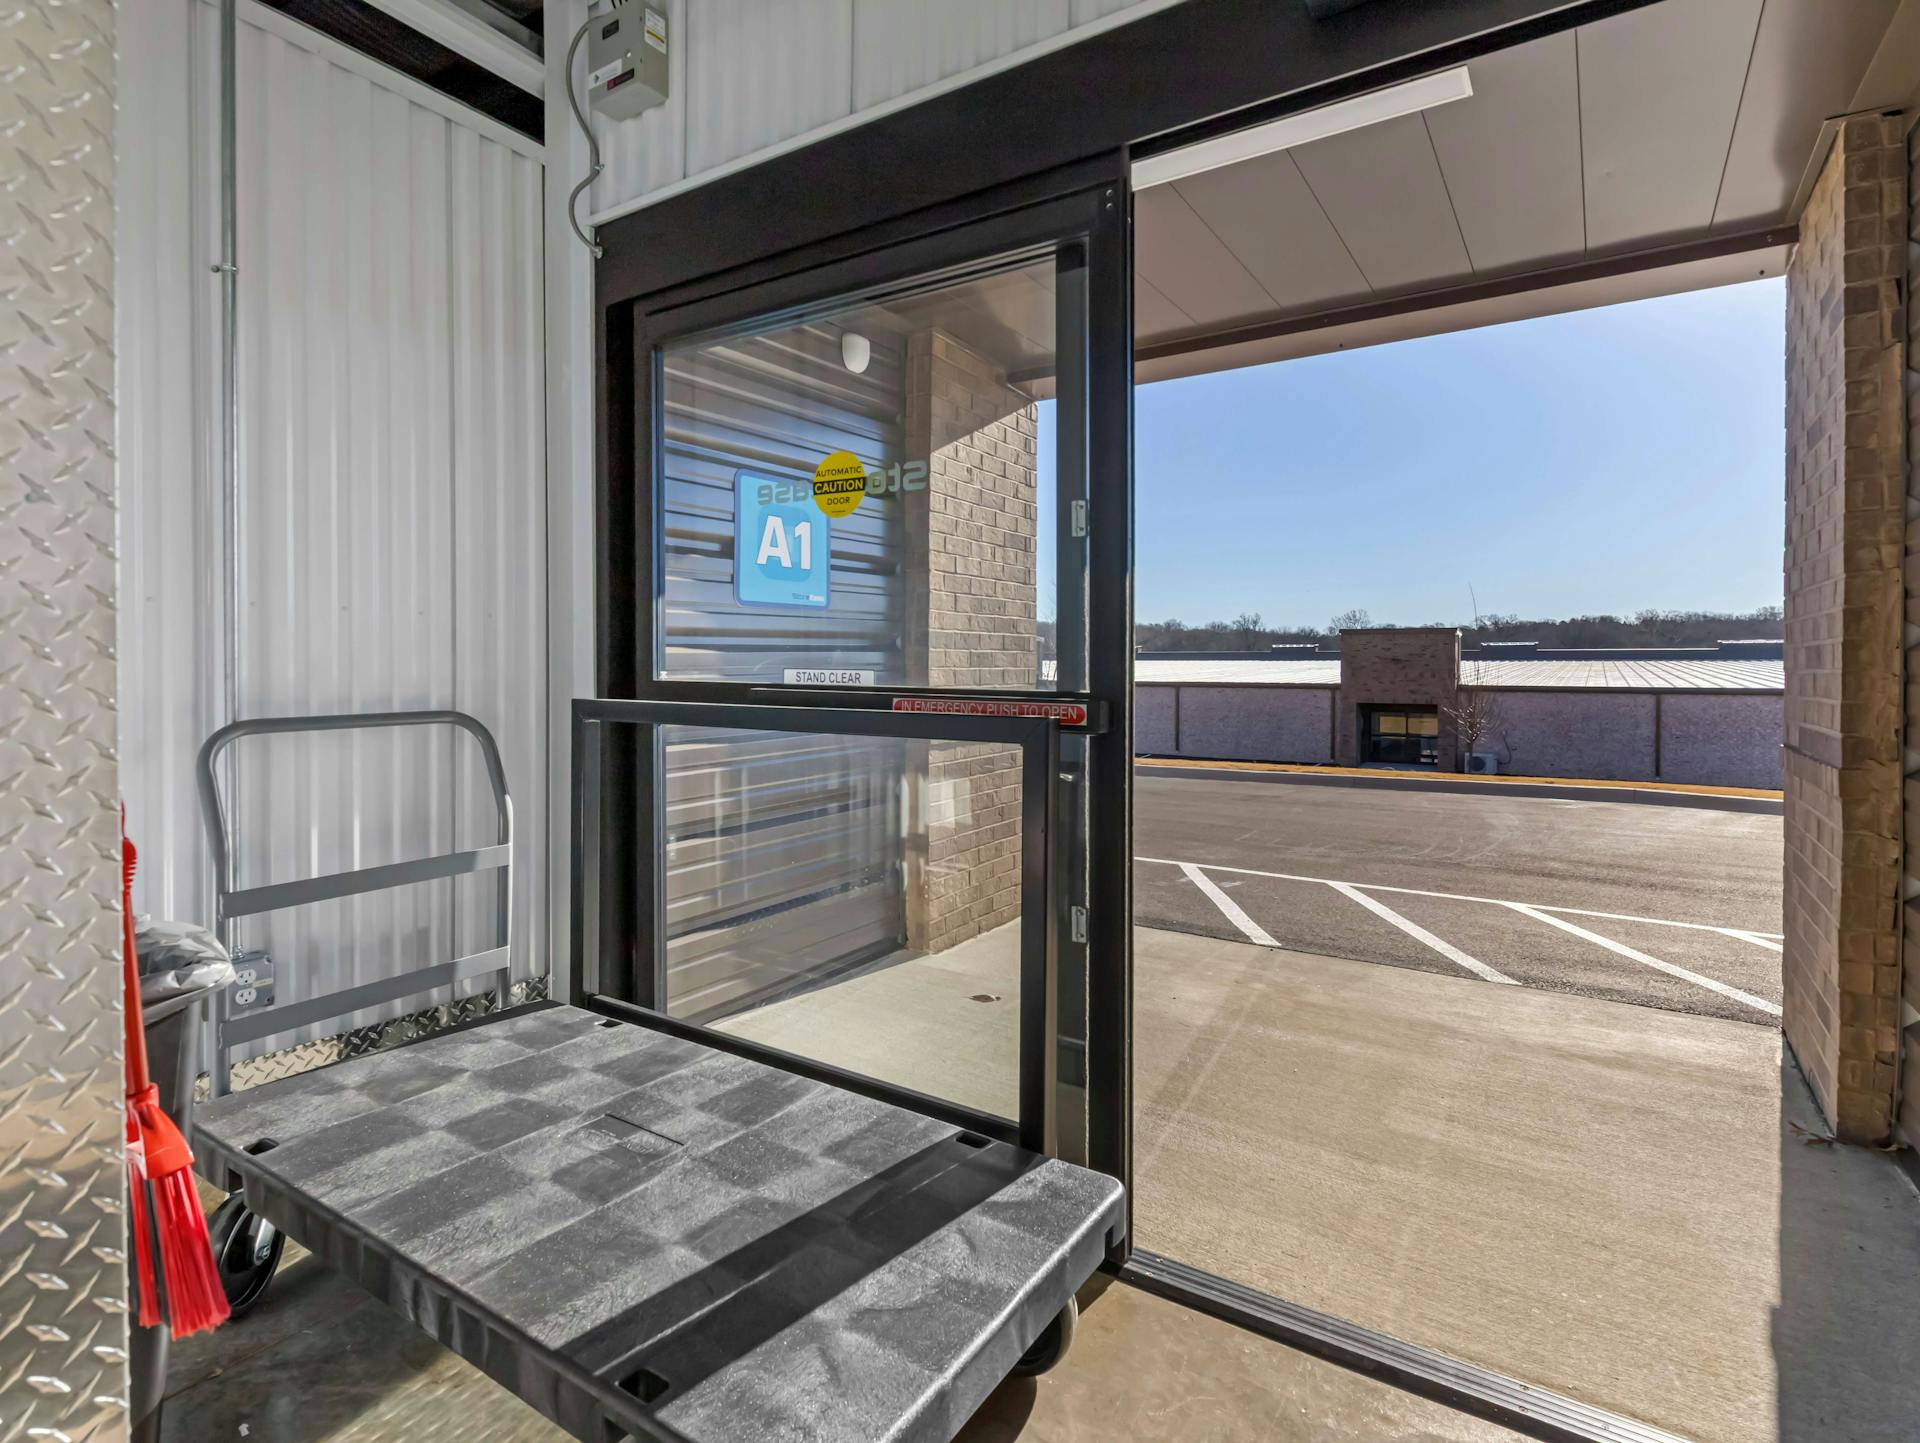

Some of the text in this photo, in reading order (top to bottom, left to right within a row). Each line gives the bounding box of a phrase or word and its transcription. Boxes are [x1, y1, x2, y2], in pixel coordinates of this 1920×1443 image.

[816, 465, 862, 477] AUTOMATIC
[814, 479, 864, 494] CAUTION
[827, 497, 850, 505] DOOR
[756, 515, 811, 570] A1
[796, 672, 862, 684] STAND CLEAR
[901, 701, 1077, 720] IN EMERGENCY PUSH TO OPEN
